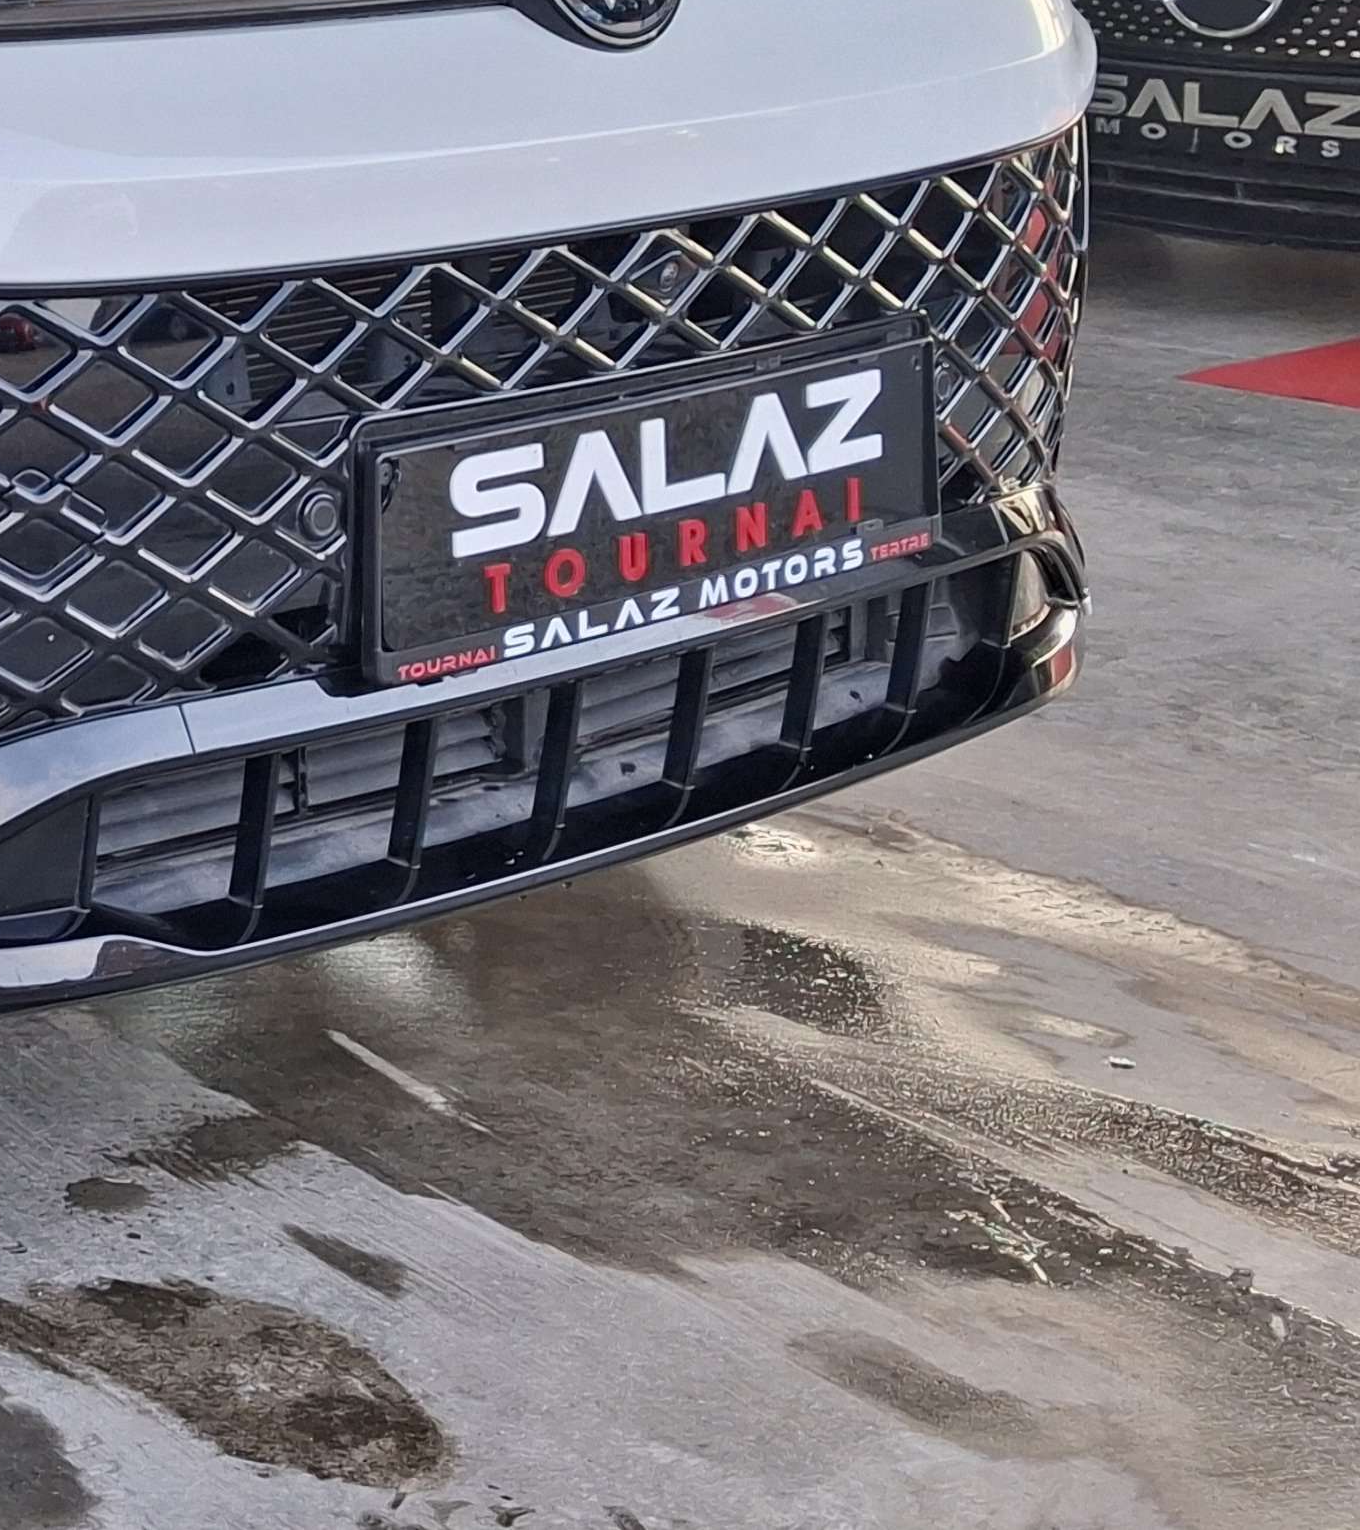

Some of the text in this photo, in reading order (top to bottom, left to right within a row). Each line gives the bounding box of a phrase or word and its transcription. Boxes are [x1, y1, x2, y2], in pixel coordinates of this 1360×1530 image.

[1087, 73, 1360, 140] SALAZ
[448, 369, 883, 558] SALAZ
[397, 532, 930, 681] TOURNAI SALAZ MOTORS TERTRE
[483, 477, 863, 614] TOURNAI
